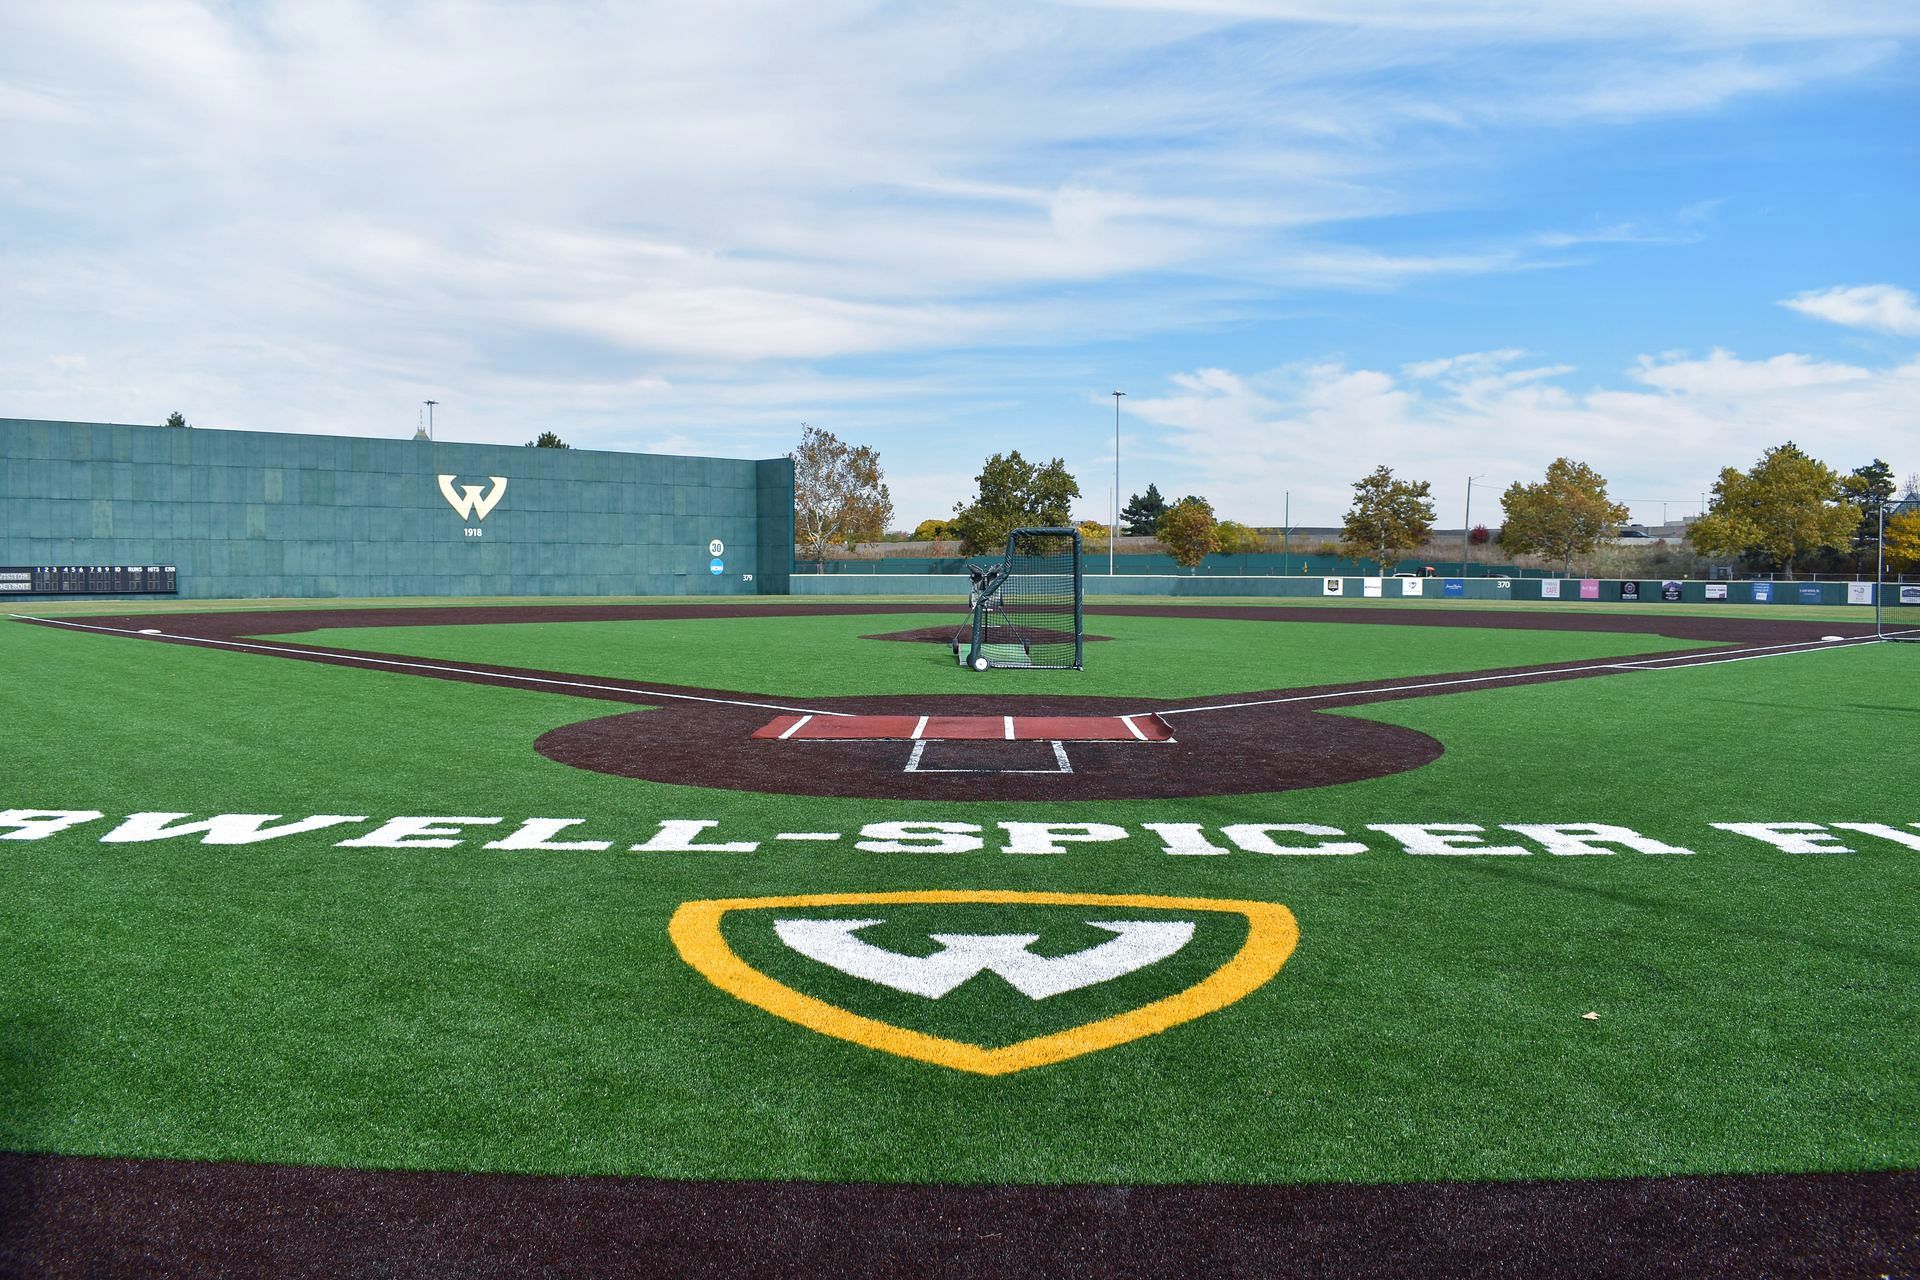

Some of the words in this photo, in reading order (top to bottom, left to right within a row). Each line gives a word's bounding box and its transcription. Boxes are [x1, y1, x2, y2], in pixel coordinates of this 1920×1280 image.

[464, 528, 482, 536] 1918
[711, 543, 722, 553] 30
[1709, 822, 1920, 853] FI
